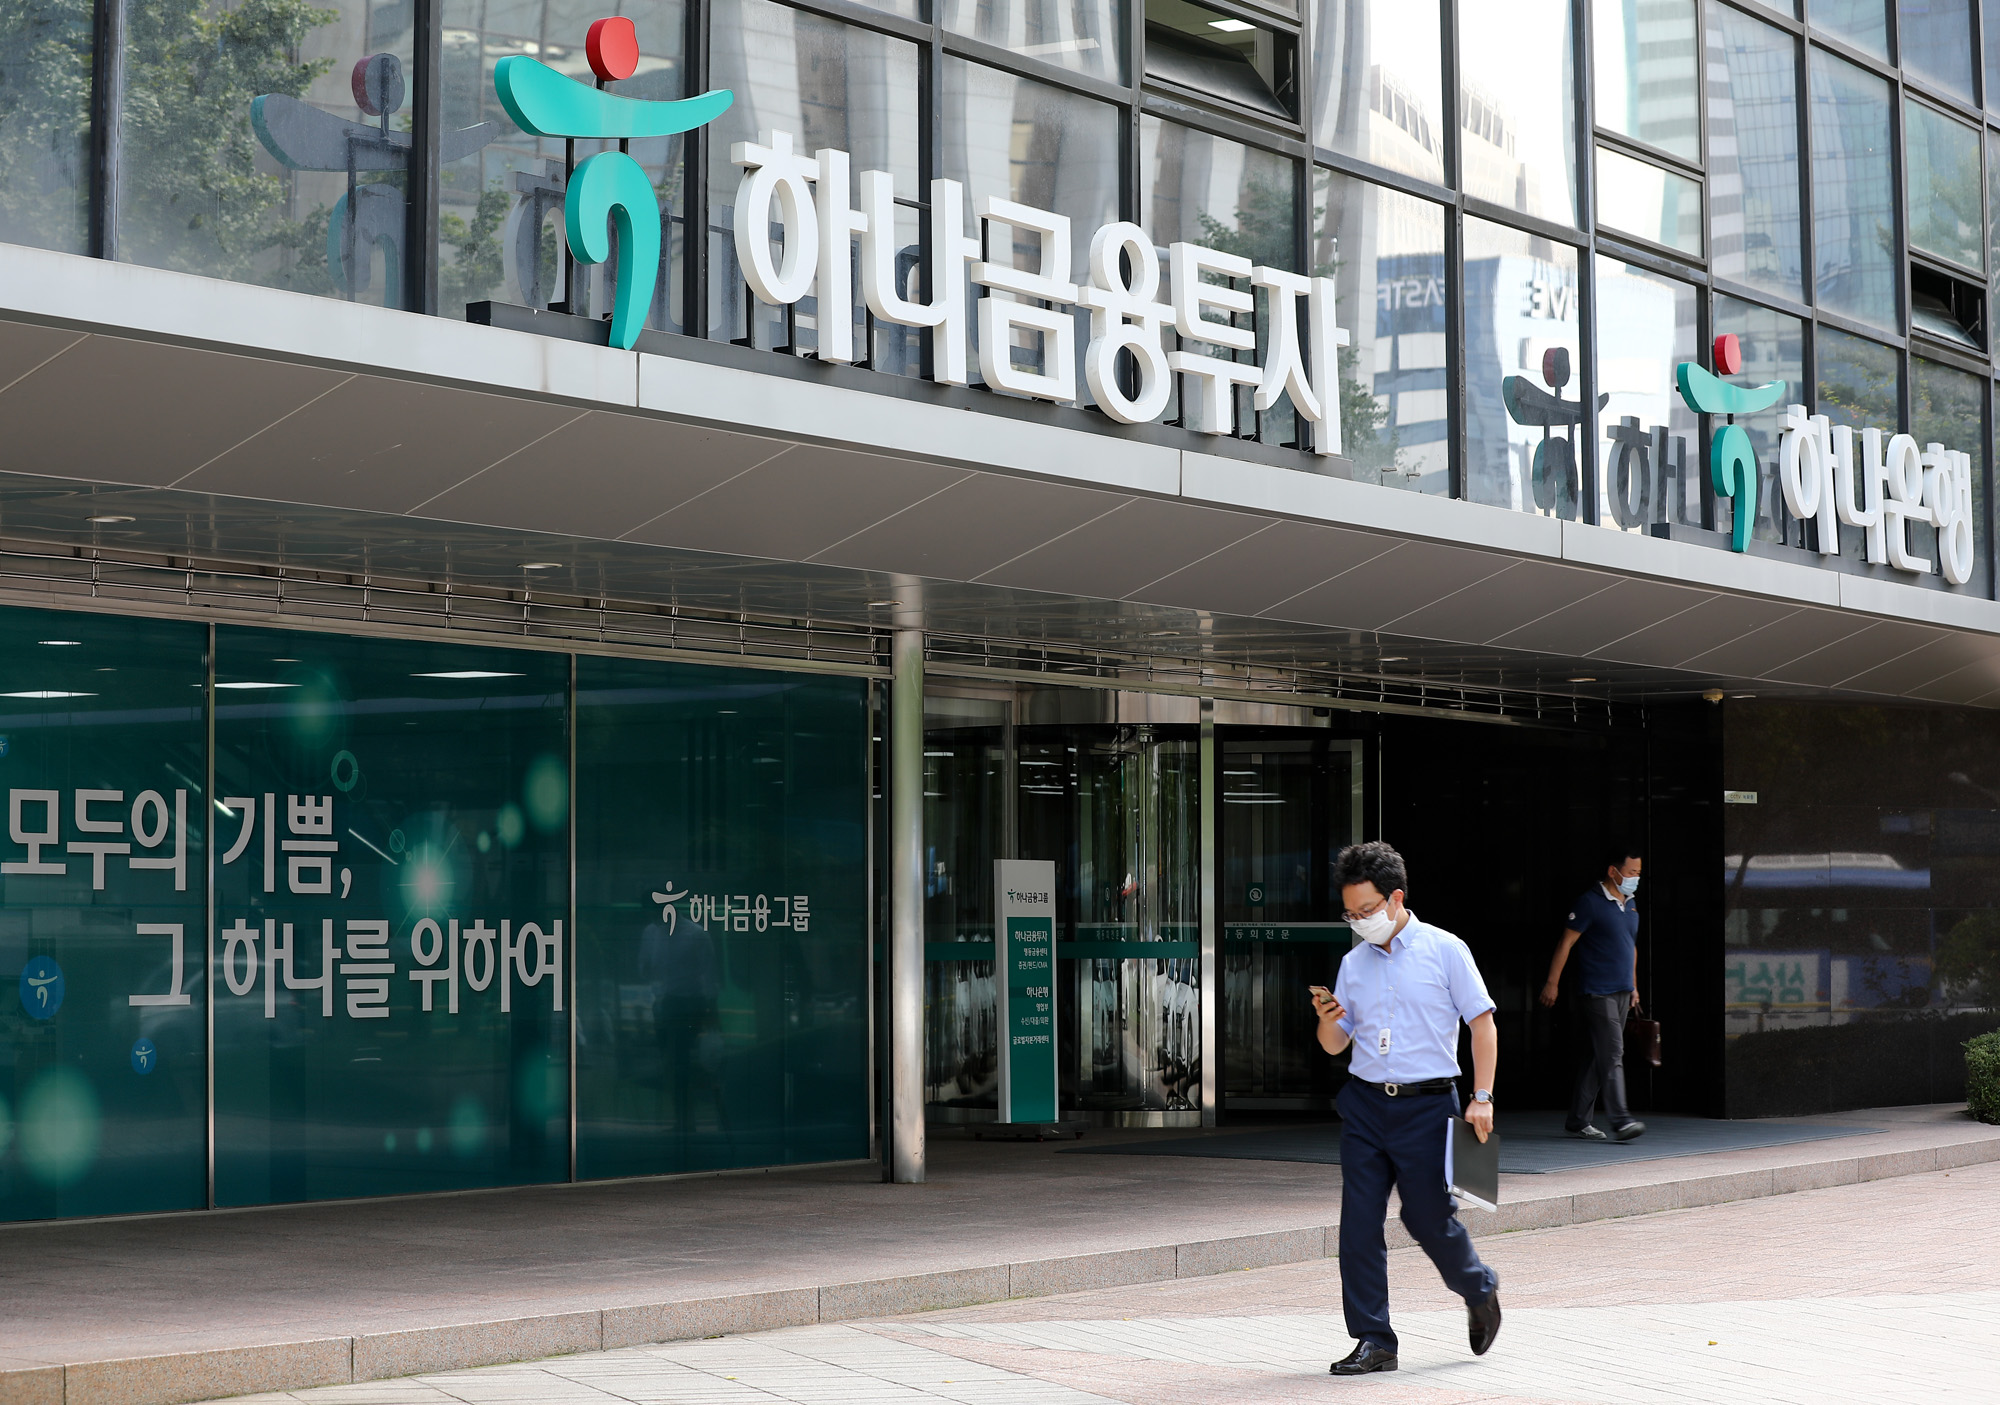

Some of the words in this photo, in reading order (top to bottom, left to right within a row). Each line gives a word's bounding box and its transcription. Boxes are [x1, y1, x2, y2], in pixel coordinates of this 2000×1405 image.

[731, 129, 1350, 456] 하나금융투자
[1777, 404, 1974, 585] 하나은행
[1, 788, 187, 892] 모두의
[221, 792, 353, 899] 기쁨,
[689, 893, 811, 933] 하나금융그룹
[1016, 892, 1048, 903] 하나금융그룹
[128, 923, 191, 1006] 그
[221, 918, 396, 1019] 하나를
[409, 917, 564, 1014] 위하여
[1014, 930, 1048, 942] 하나금융투자
[1026, 986, 1049, 998] 하나은행
